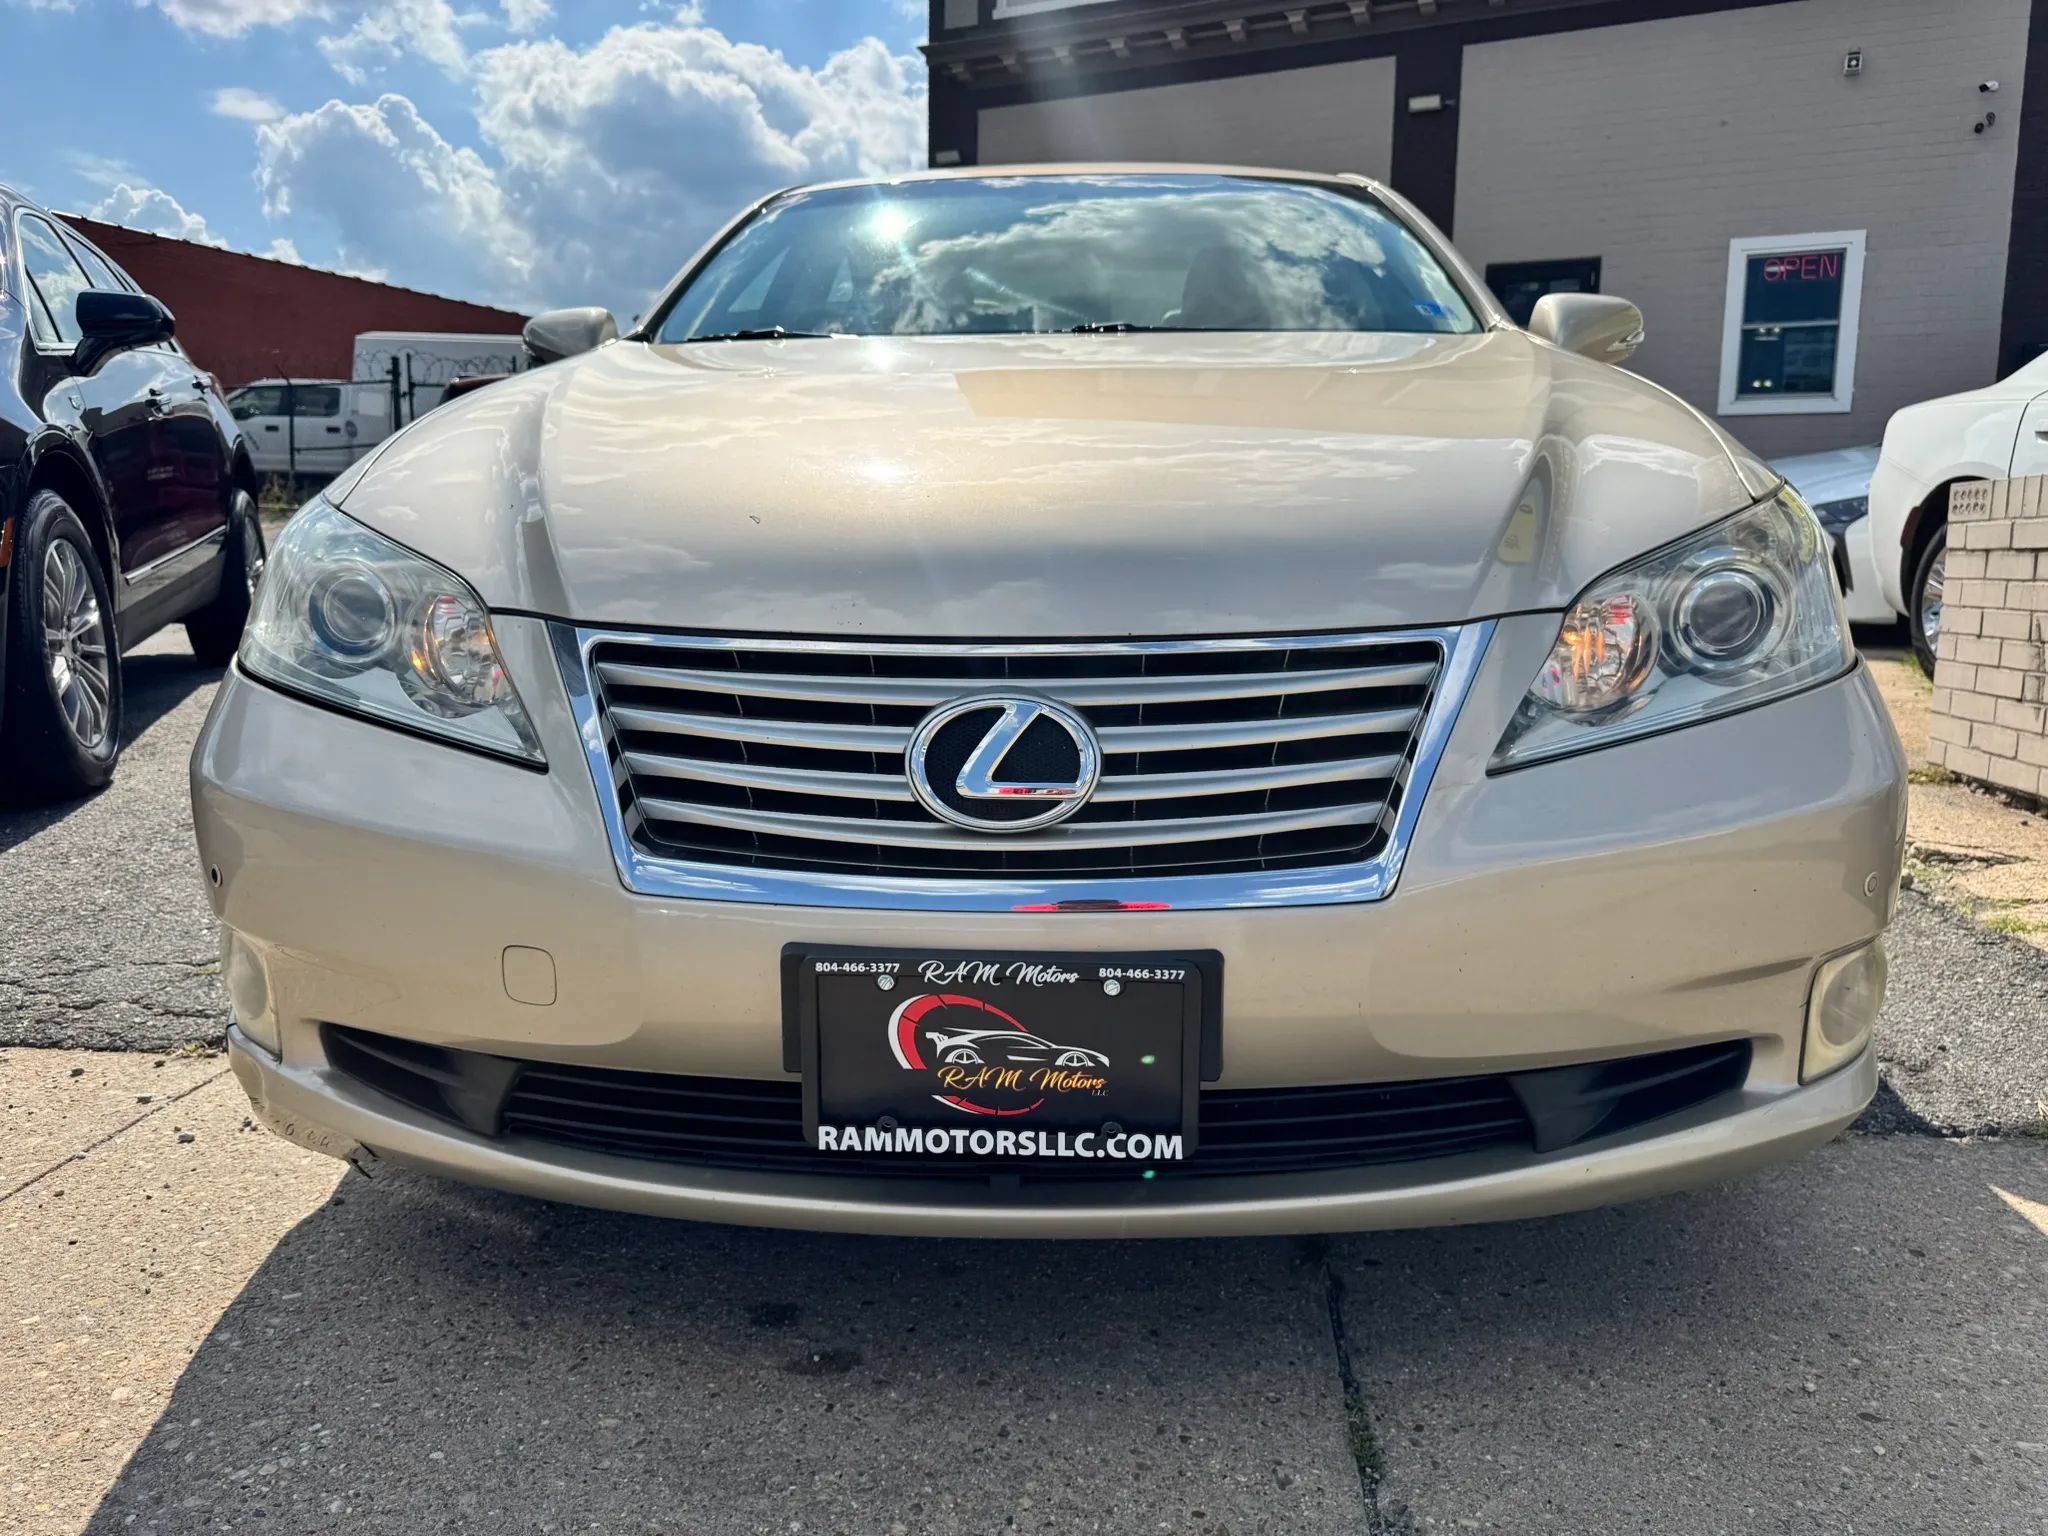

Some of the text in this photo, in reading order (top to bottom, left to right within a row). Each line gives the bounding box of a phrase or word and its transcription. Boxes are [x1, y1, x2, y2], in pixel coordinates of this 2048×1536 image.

[1763, 254, 1838, 282] OPEN
[815, 962, 900, 973] 804-466-3377
[917, 960, 1079, 987] RAM Motors
[1099, 968, 1185, 980] 804-466-3377
[937, 1065, 1108, 1093] RAM Motors
[818, 1126, 1183, 1160] RAMMOTORSLLC.COM
